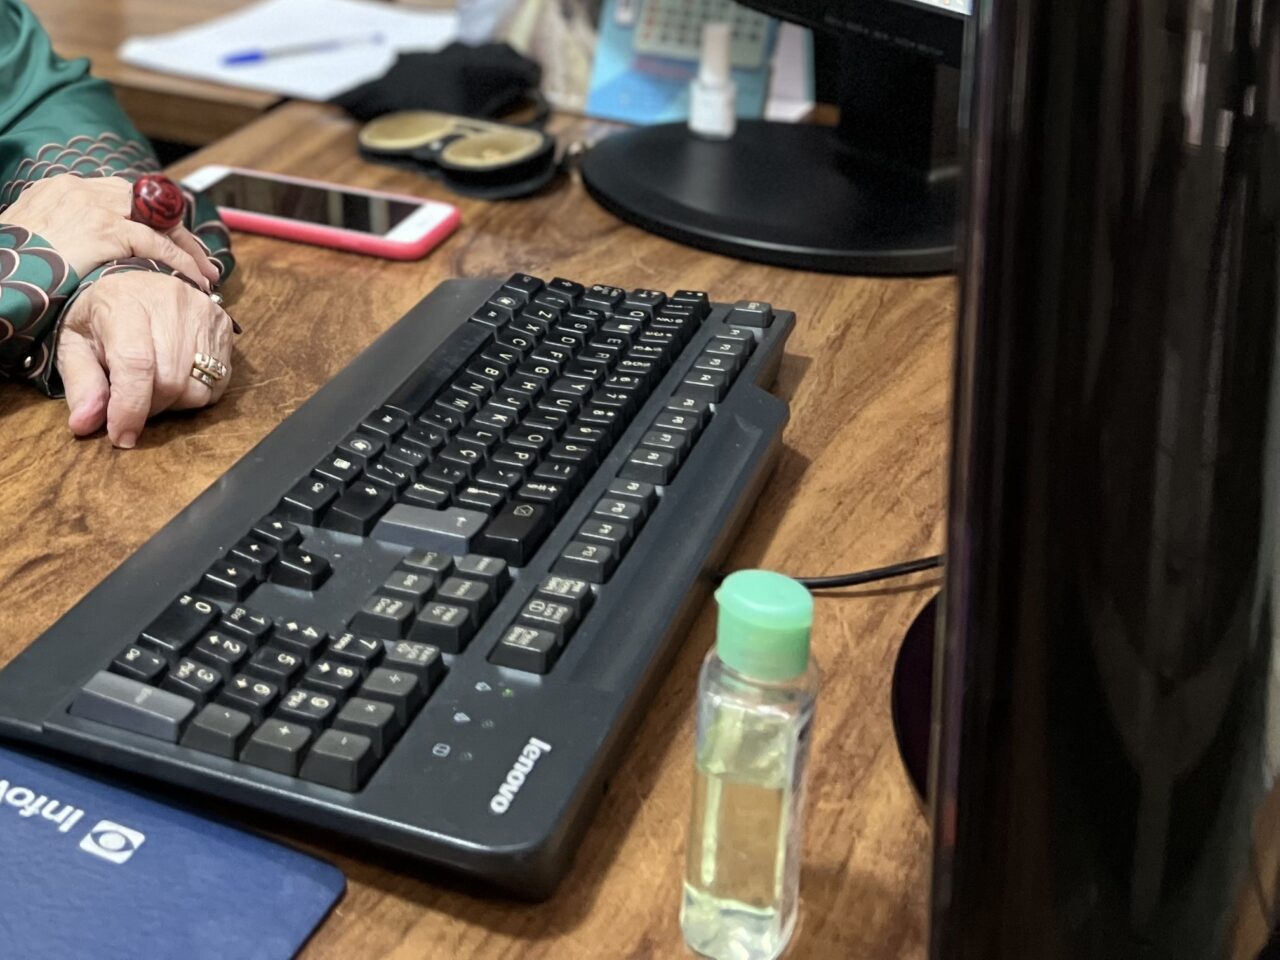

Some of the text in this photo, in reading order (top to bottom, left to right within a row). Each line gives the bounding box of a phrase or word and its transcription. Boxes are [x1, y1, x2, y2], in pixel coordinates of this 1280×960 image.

[194, 601, 212, 614] 0
[249, 616, 265, 625] 1
[302, 626, 319, 638] 4
[222, 640, 241, 654] 2
[359, 639, 377, 650] 7
[277, 653, 296, 666] 5
[196, 668, 214, 682] 3
[336, 666, 354, 678] 8
[253, 683, 271, 696] 6
[310, 696, 330, 709] 9
[489, 736, 553, 814] lenovo
